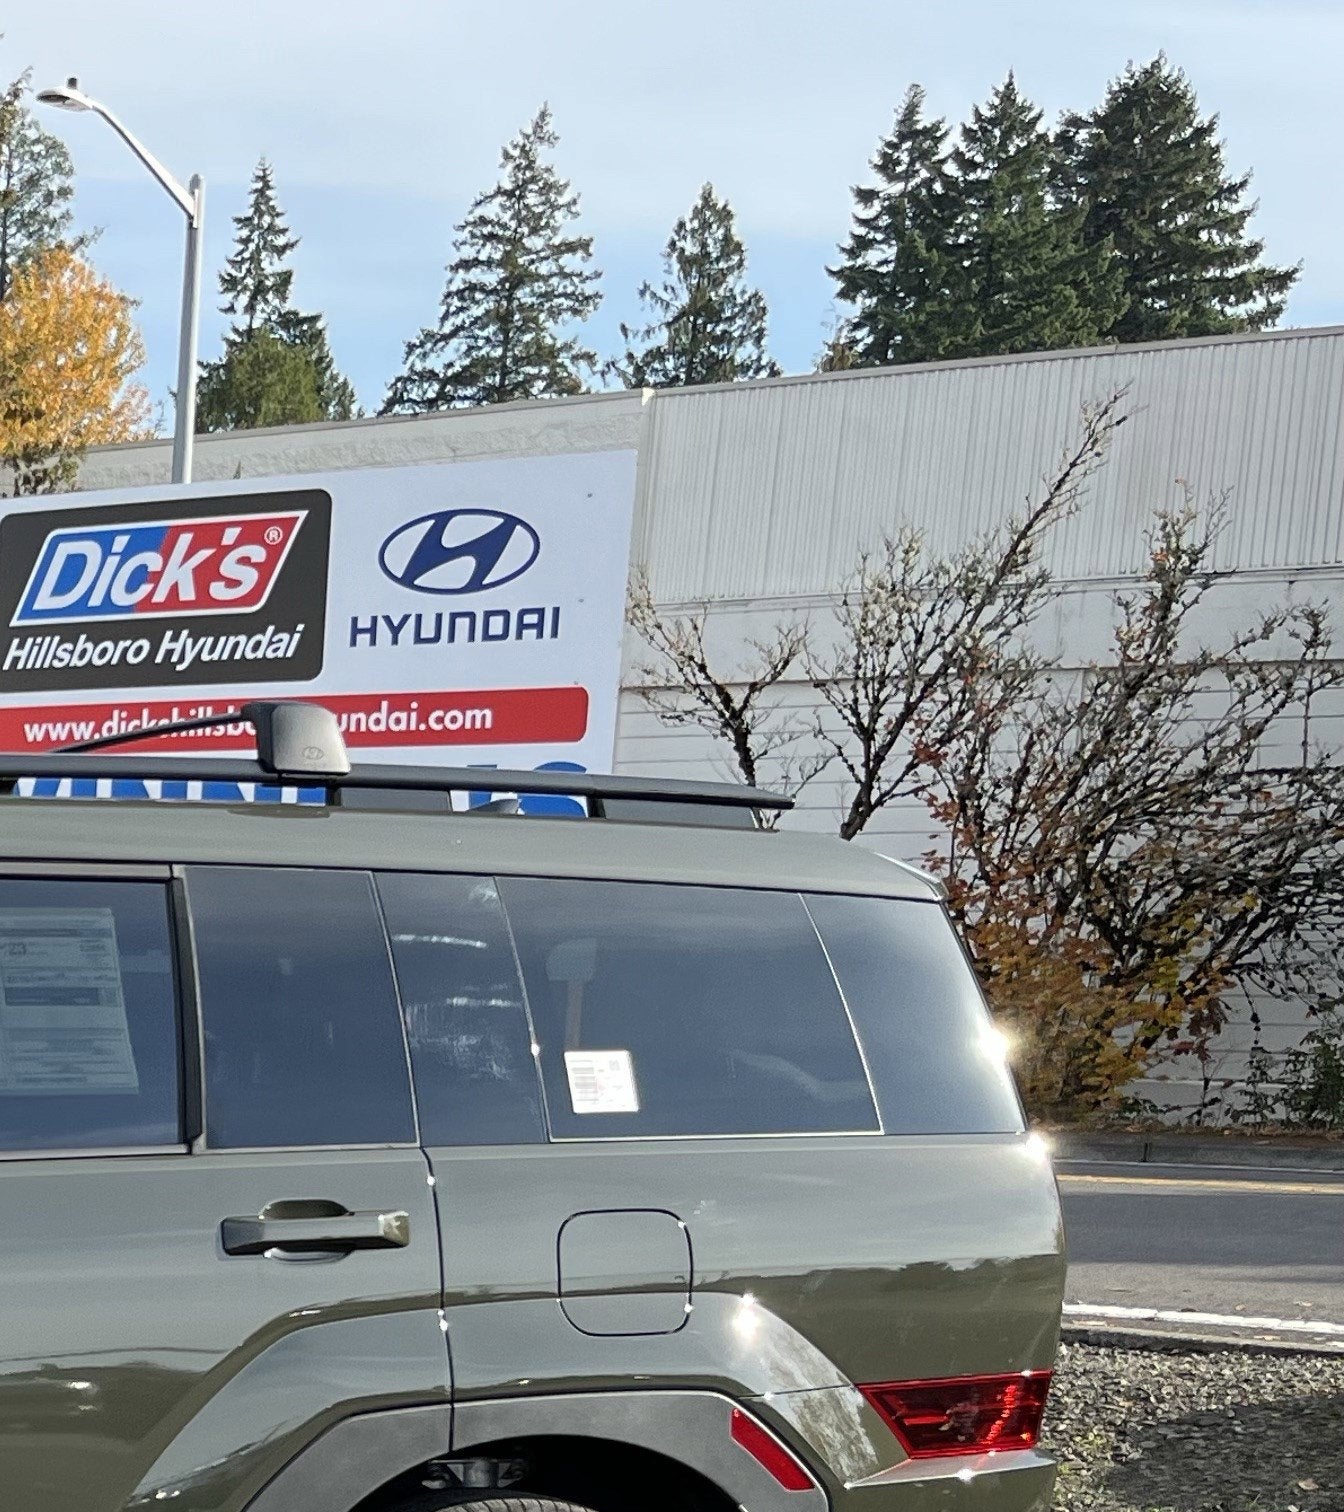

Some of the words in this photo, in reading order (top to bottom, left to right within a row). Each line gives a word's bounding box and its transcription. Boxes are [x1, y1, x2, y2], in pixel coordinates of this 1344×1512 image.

[2, 634, 151, 671] Hillsboro
[154, 624, 305, 671] Hyundai
[349, 606, 561, 648] HYUNDAI
